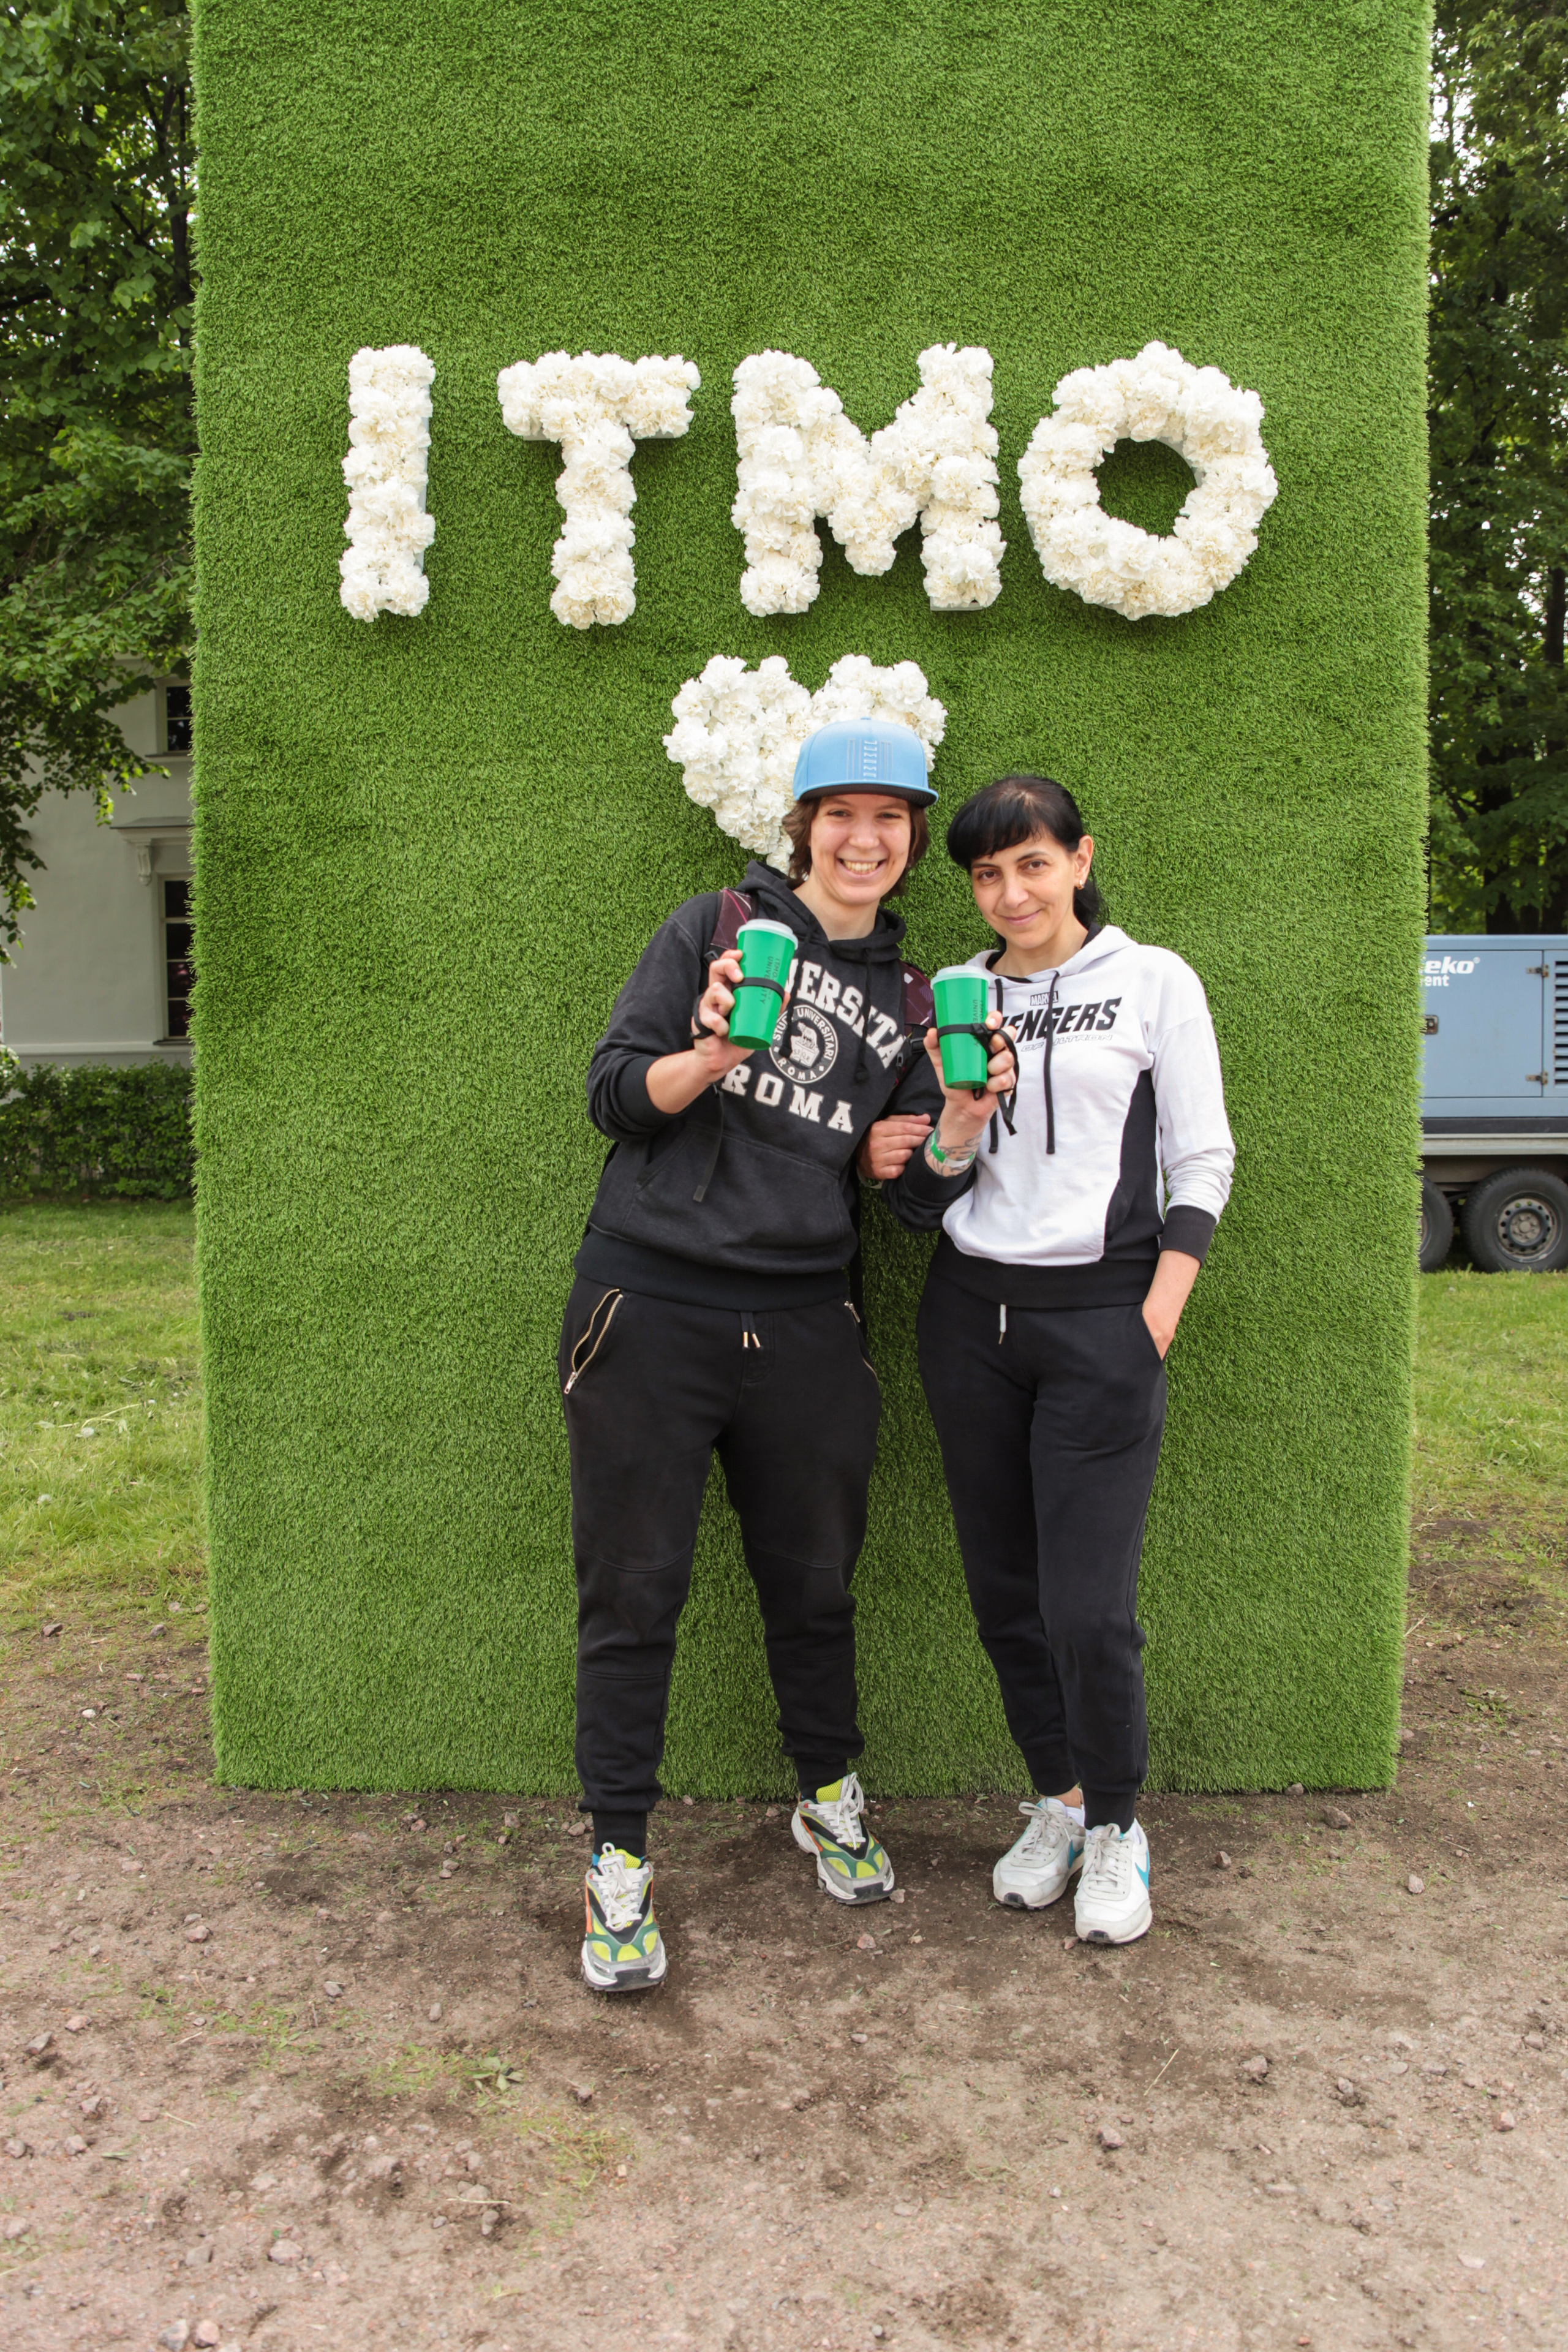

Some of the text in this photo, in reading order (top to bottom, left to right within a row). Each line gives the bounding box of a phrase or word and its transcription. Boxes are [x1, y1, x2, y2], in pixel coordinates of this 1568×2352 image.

[339, 341, 1278, 629] ITMO
[1419, 956, 1474, 974] eko
[760, 956, 774, 1004] UNIVEITY
[1419, 974, 1449, 987] ent
[1030, 991, 1058, 1006] MARVL
[797, 1008, 835, 1060] UNIVERSITARI
[1021, 1041, 1044, 1052] OF
[778, 1057, 816, 1080] ROMA
[721, 1064, 854, 1134] ROMA
